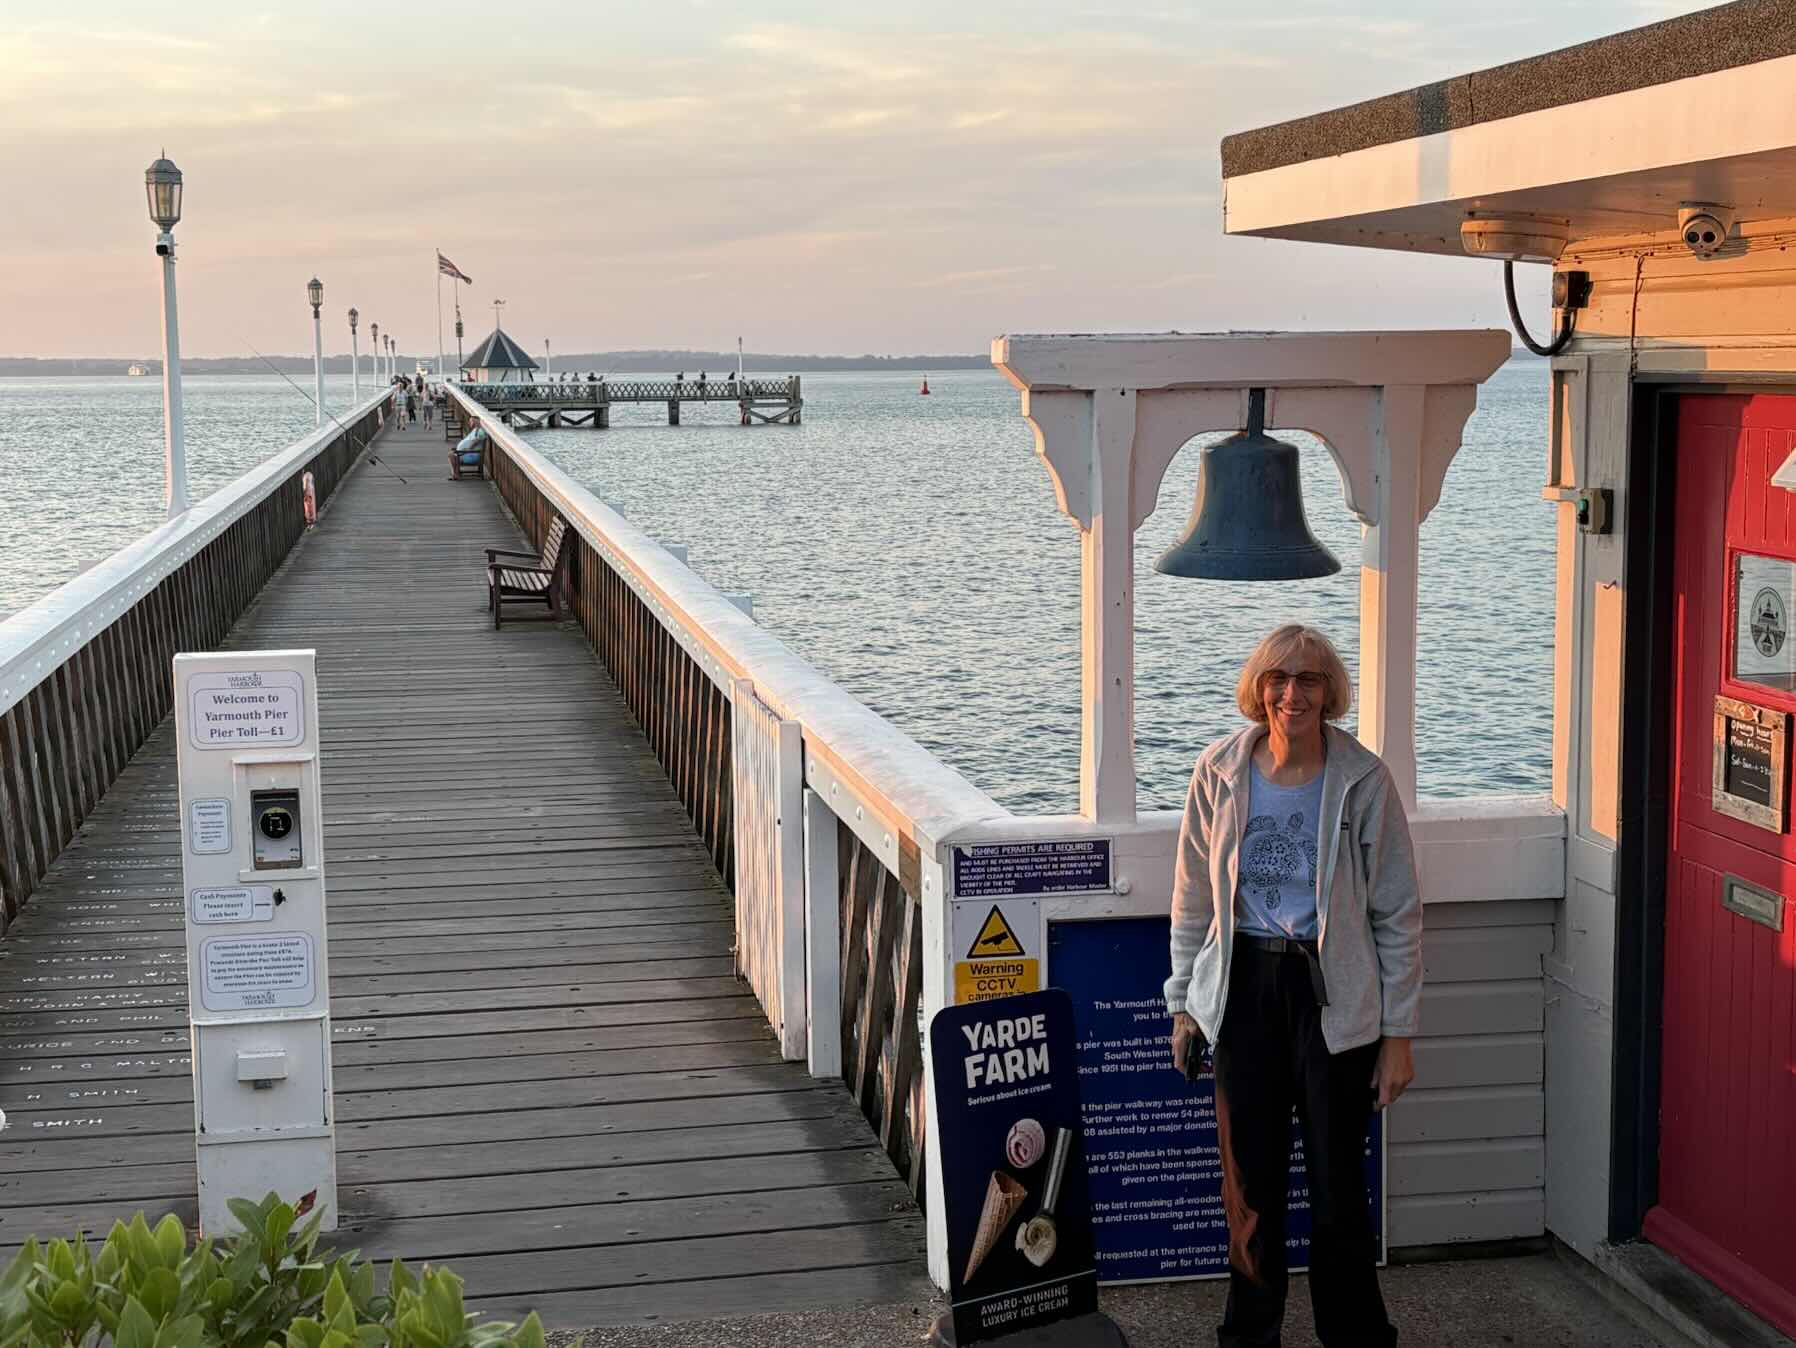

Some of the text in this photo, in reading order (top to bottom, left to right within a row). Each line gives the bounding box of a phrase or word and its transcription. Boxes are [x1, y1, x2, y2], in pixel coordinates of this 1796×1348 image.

[213, 694, 279, 704] Welcome to
[205, 709, 288, 721] Yarmouth Pier
[210, 728, 234, 738] Pier
[973, 843, 1094, 855] ISHING PERMITS ARE REQUIRED
[970, 962, 1024, 976] Warning
[977, 978, 1016, 991] CCTV
[1094, 1001, 1111, 1010] The
[1113, 999, 1156, 1009] Yarmouth
[1133, 1012, 1149, 1022] you
[1151, 1011, 1161, 1020] to
[961, 1014, 1048, 1052] YARDE
[1083, 1041, 1101, 1051] pier
[1123, 1037, 1142, 1046] built
[1144, 1036, 1153, 1045] in
[1104, 1049, 1170, 1061] South Western
[964, 1043, 1050, 1089] FARM
[1101, 1064, 1118, 1073] 1951
[1121, 1063, 1135, 1072] the
[1136, 1062, 1155, 1072] pier
[1156, 1061, 1172, 1070] has
[967, 1083, 1052, 1106] Serious about ice cream
[1088, 1096, 1213, 1112] the pier walkway was rebuilt
[1115, 1113, 1138, 1122] work
[1140, 1113, 1149, 1121] to
[1181, 1109, 1192, 1118] 54
[1194, 1109, 1215, 1118] piles
[32, 1118, 103, 1128] SMITH
[1097, 1126, 1135, 1136] assisted
[1136, 1125, 1147, 1135] by
[1157, 1123, 1182, 1133] major
[1184, 1121, 1218, 1130] donatio
[1127, 1149, 1155, 1160] planks
[1156, 1148, 1166, 1157] in
[1167, 1147, 1181, 1156] the
[1088, 1159, 1221, 1174] all of which have been sponsor
[1121, 1176, 1145, 1186] given
[1146, 1175, 1159, 1183] on
[1160, 1173, 1175, 1182] the
[1176, 1171, 1210, 1182] plaques
[1095, 1195, 1222, 1211] the last remaining all-wooden
[1105, 1213, 1122, 1223] and
[1123, 1213, 1149, 1221] cross
[1150, 1210, 1184, 1220] bracing
[1201, 1207, 1225, 1215] made
[1172, 1220, 1226, 1231] used for the
[1102, 1248, 1149, 1260] requested
[1150, 1248, 1159, 1257] at
[1161, 1247, 1176, 1256] the
[1177, 1245, 1216, 1255] entrance
[1218, 1243, 1228, 1252] to
[1160, 1260, 1177, 1270] pier
[1180, 1258, 1193, 1267] for
[1194, 1257, 1221, 1266] future
[981, 1284, 1069, 1316] AWARD-WINNING
[982, 1297, 1069, 1328] LUXURY ICE CREAM
